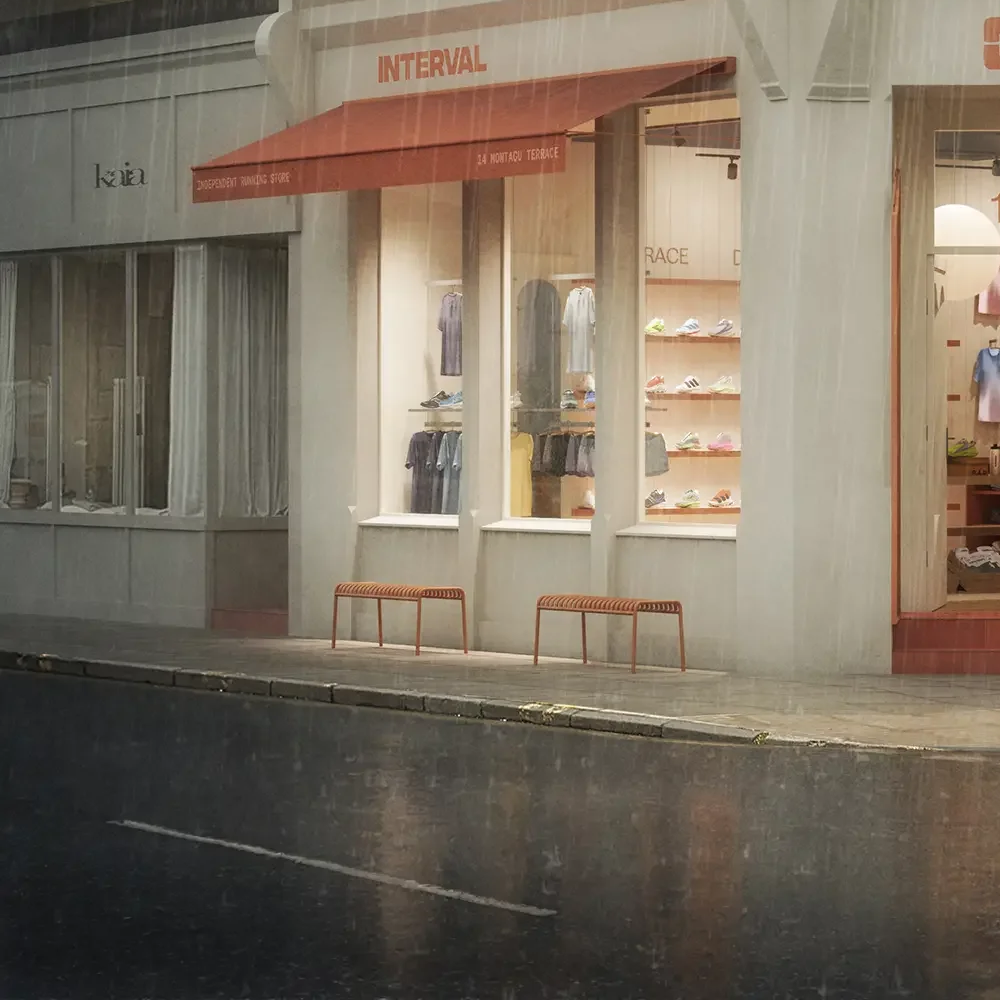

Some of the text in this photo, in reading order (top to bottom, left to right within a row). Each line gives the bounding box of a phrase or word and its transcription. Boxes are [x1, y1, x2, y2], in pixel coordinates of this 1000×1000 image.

[378, 45, 487, 83] INTERVAL
[477, 146, 559, 165] 14 MONTAGU TERRACE
[196, 172, 290, 190] INDEPENDENT RUNNING STORE
[644, 246, 688, 265] RACE
